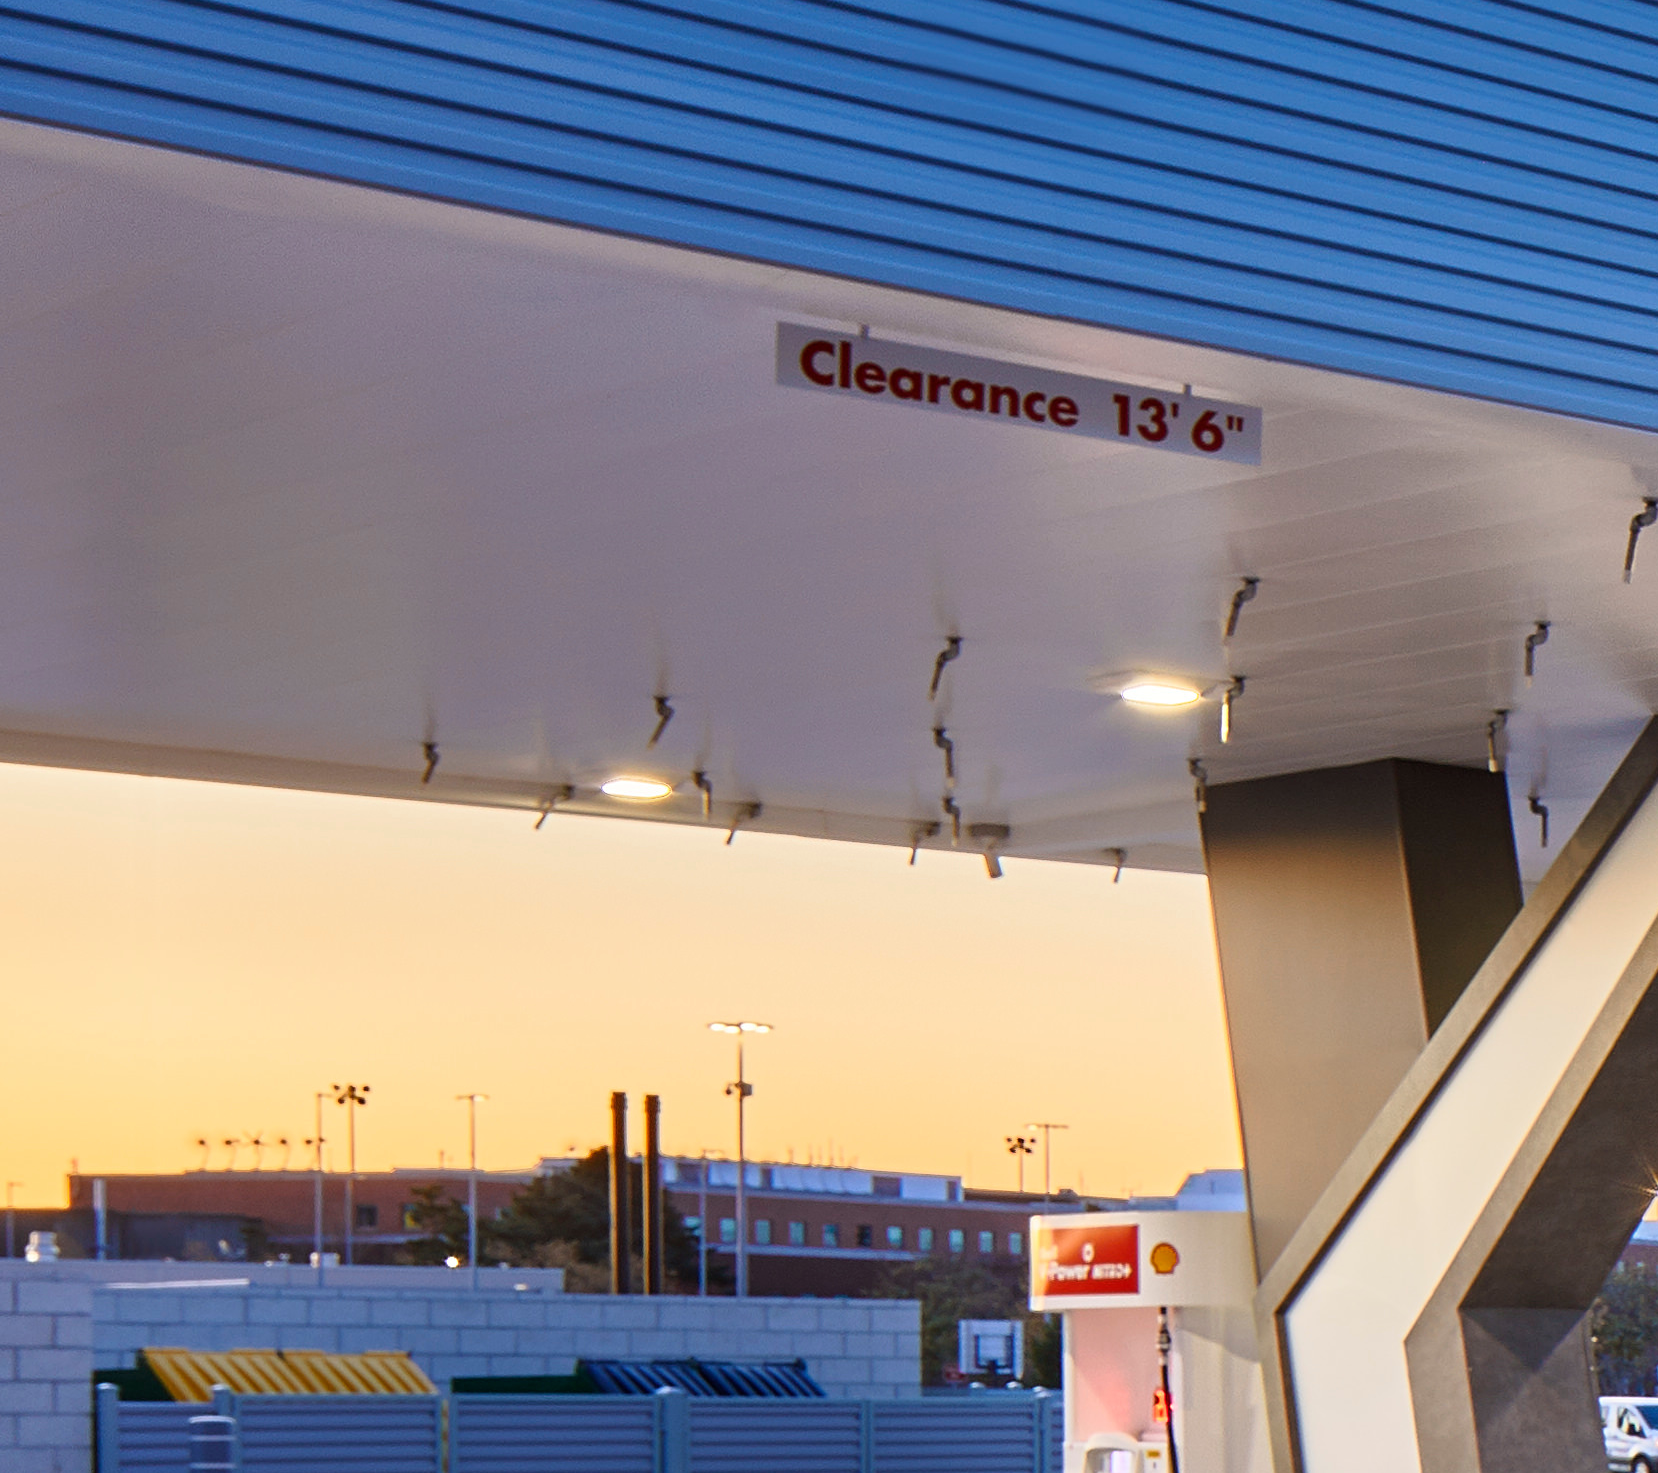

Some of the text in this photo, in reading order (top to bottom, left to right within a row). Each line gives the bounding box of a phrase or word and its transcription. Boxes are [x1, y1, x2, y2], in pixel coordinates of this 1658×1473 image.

[800, 339, 1245, 453] Clearance 13' 6"
